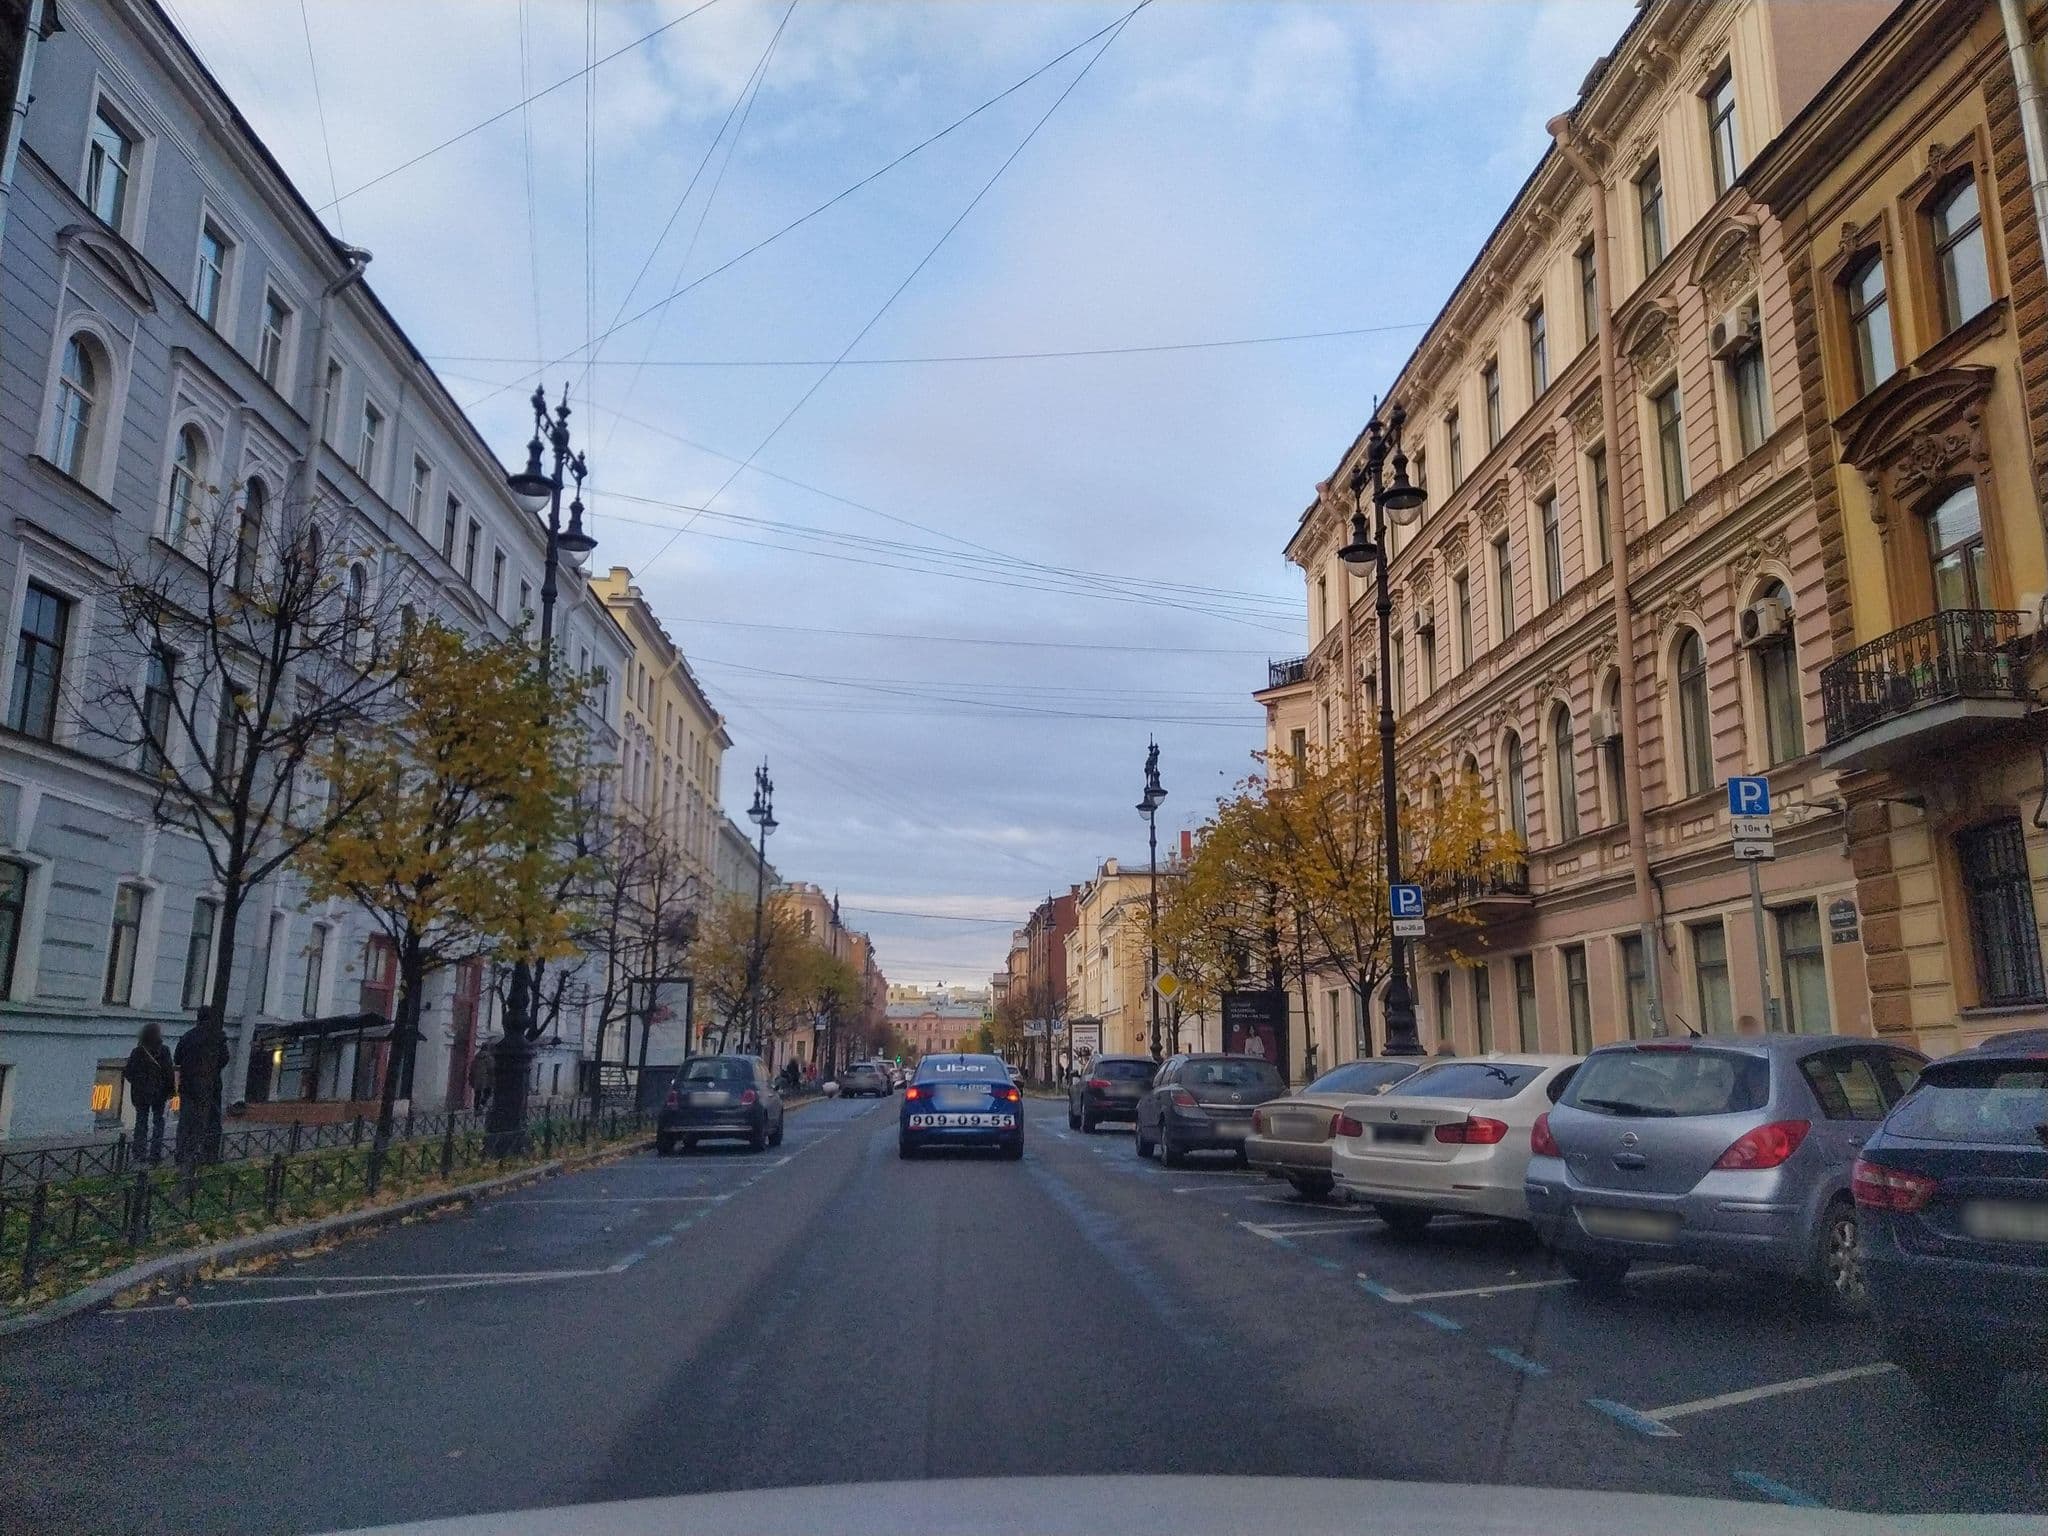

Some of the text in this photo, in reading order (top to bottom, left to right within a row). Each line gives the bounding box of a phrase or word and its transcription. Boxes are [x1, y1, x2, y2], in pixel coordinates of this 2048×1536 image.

[1739, 781, 1761, 811] P
[1398, 888, 1417, 913] P
[936, 1064, 987, 1072] Uber
[912, 1115, 1012, 1125] 909-09-55
